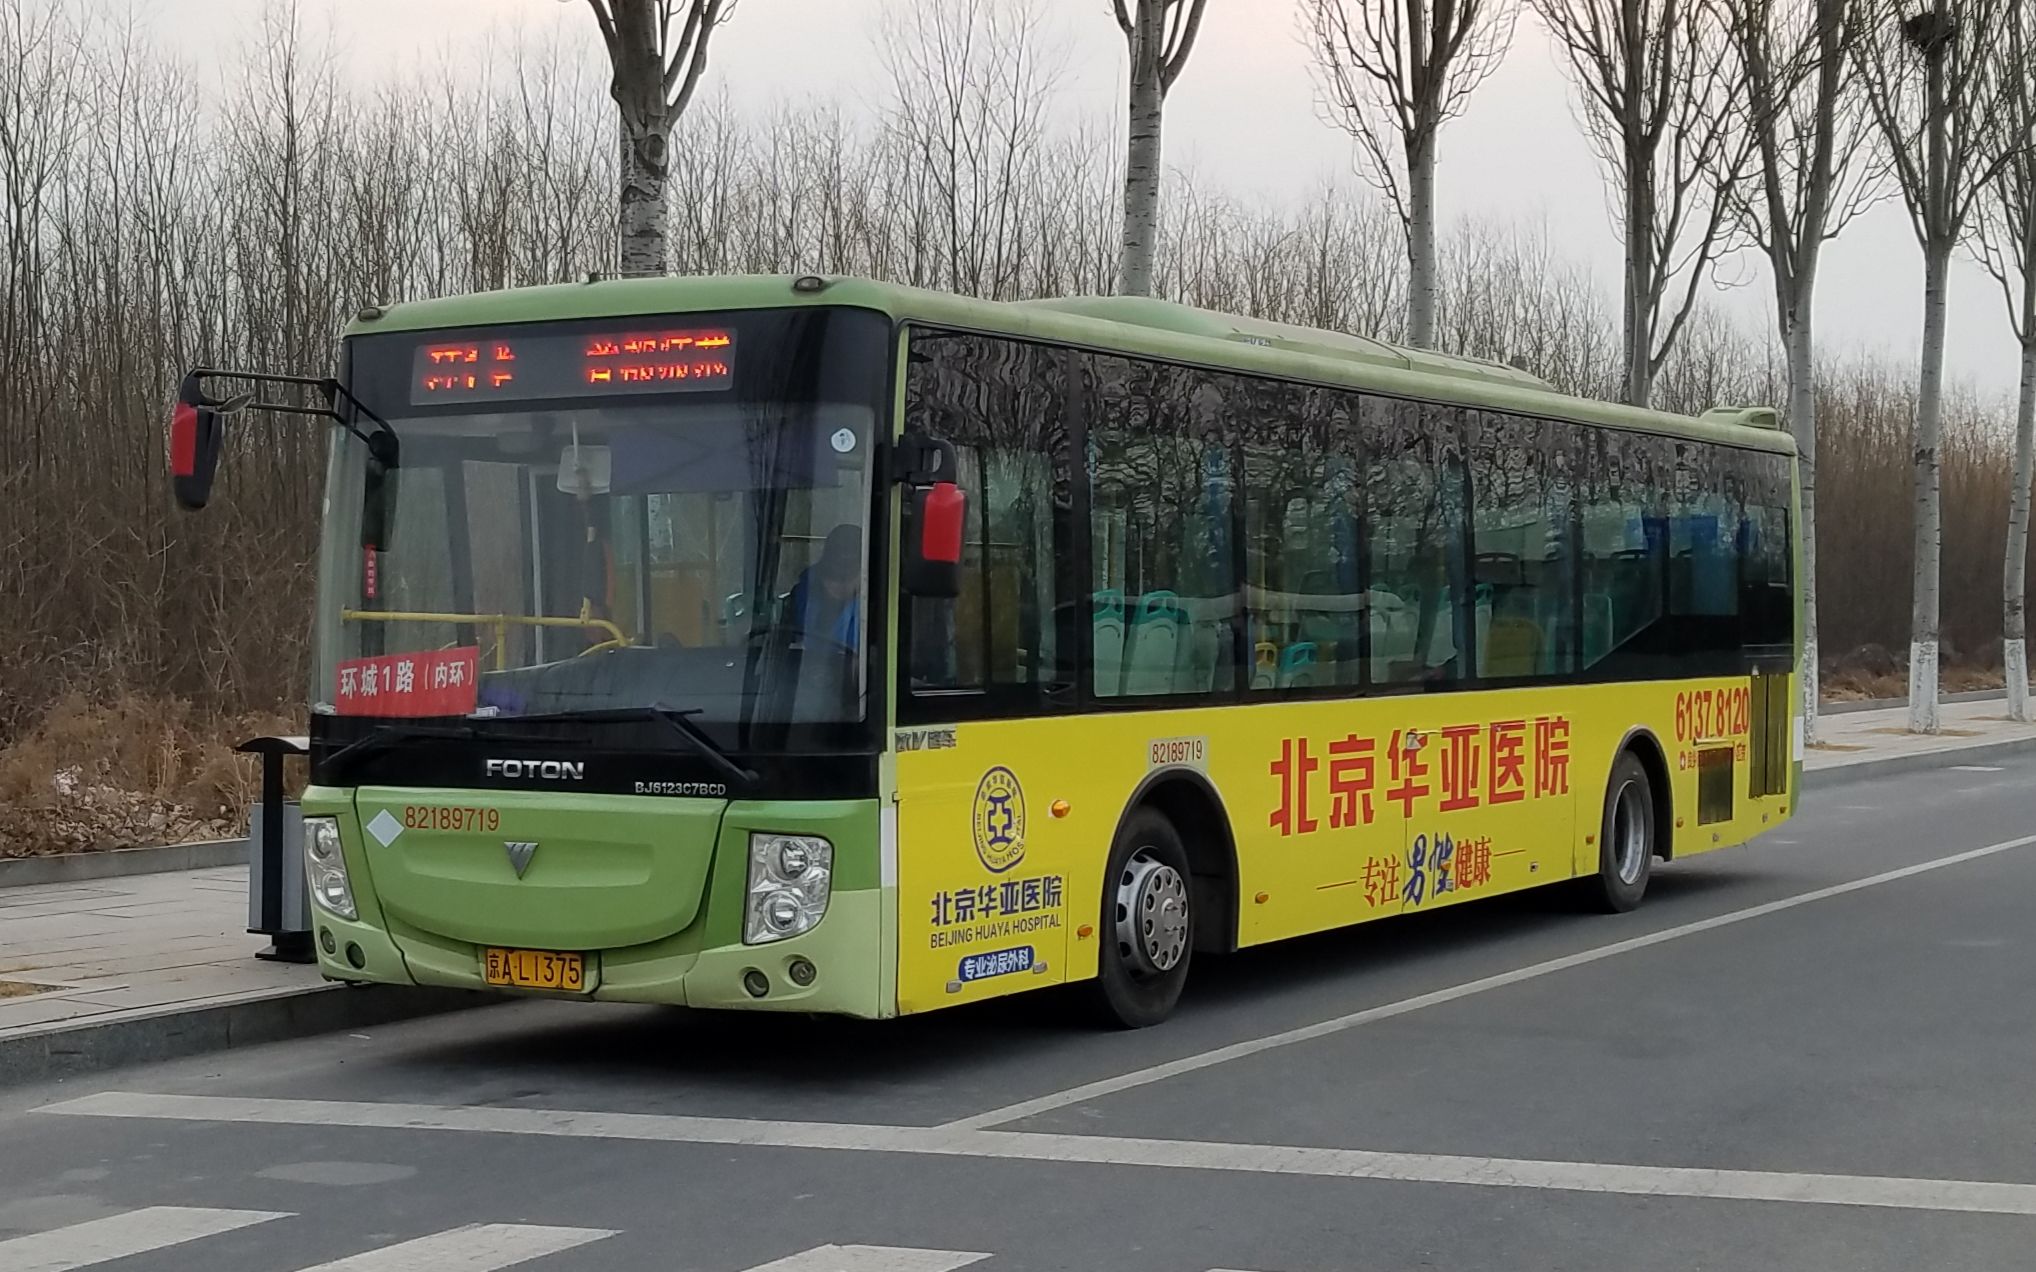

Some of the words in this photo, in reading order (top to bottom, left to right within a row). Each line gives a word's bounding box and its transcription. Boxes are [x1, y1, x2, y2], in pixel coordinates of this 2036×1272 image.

[486, 759, 585, 780] FOTON
[1152, 740, 1203, 763] 82189719
[1270, 716, 1570, 836] 北京华亚医院
[404, 806, 500, 832] 82189719
[1360, 832, 1493, 907] 专注男性健康
[931, 875, 1062, 927] 北京华亚医院
[930, 927, 973, 949] BEIJING
[975, 922, 1010, 941] HUAYA
[1012, 913, 1062, 935] HOSPITAL
